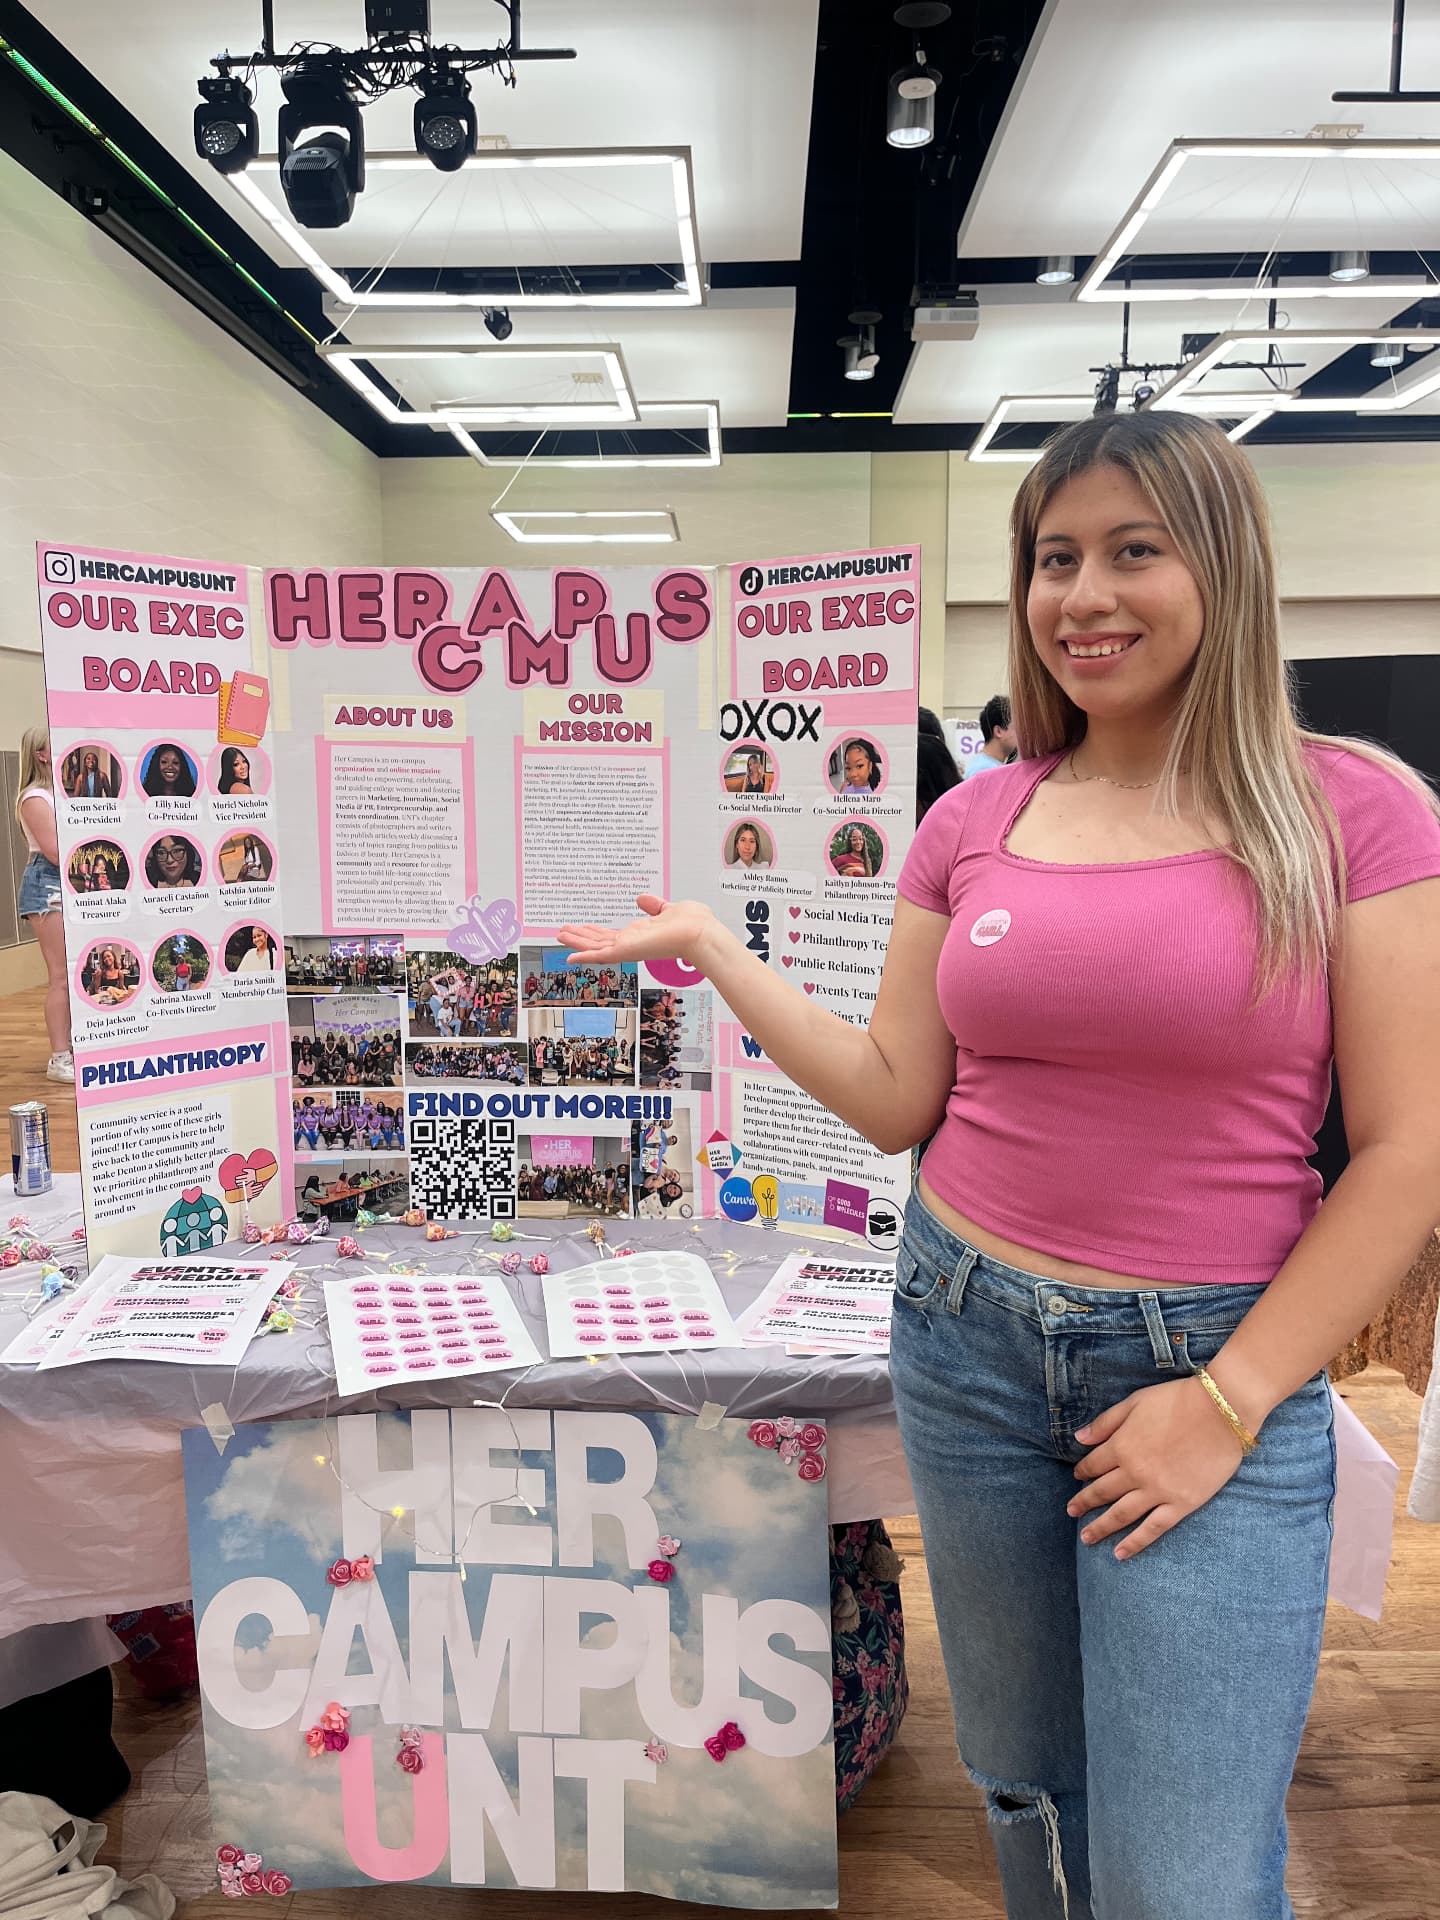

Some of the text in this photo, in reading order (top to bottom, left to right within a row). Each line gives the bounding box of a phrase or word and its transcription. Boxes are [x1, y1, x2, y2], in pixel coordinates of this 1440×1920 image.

[80, 560, 235, 592] HERCAMPUSUNT
[768, 554, 912, 585] HERCAMPUSUNT
[48, 592, 244, 640] OUR EXEC
[270, 572, 448, 642] HER
[738, 589, 914, 638] OUR EXEC
[83, 656, 221, 694] BOARD
[763, 653, 888, 693] BOARD
[568, 693, 623, 715] OUR
[335, 706, 454, 729] ABOUT US
[539, 721, 652, 743] MISSION
[148, 813, 198, 821] Co-President
[233, 812, 267, 820] President
[719, 804, 750, 812] Co-Social
[773, 805, 802, 813] Director
[813, 807, 902, 815] Co-Social Media Director
[68, 816, 121, 825] Co-President
[758, 885, 784, 895] Publicity
[786, 888, 812, 896] Director
[825, 879, 896, 889] Kaitlyn Johnson-Pra
[224, 897, 271, 907] Senior Editor
[825, 891, 896, 901] Philanthropy Direct
[81, 910, 120, 919] Treasurer
[160, 905, 194, 914] Secretary
[804, 908, 834, 921] Social
[837, 910, 869, 924] Media
[803, 933, 868, 951] Philanthropy
[794, 957, 825, 970] Public
[828, 960, 875, 975] Relations
[234, 978, 253, 986] Daria
[816, 984, 849, 998] Events
[151, 993, 211, 1005] Sabrina Maxwell
[222, 988, 266, 999] Membership
[147, 1004, 216, 1017] Co-Events Director
[87, 1015, 136, 1028] Deja Jackson
[74, 1025, 149, 1043] Co-Events Director
[82, 1042, 266, 1088] PHILANTHROPY
[753, 1083, 766, 1092] Her
[768, 1086, 797, 1097] Campus,
[408, 1092, 672, 1120] FIND OUT MORE!!!
[744, 1094, 788, 1107] Development
[90, 1103, 202, 1131] Community service is good
[744, 1105, 841, 1127] further develop their college
[91, 1112, 221, 1145] portion of why some of these girls
[744, 1118, 848, 1140] prepare them for their desired
[91, 1123, 225, 1157] joined! Her Campus is here to help
[744, 1129, 781, 1140] workshops
[797, 1137, 847, 1152] career-related
[849, 1147, 871, 1157] events
[92, 1159, 109, 1170] give
[111, 1154, 130, 1165] back
[156, 1141, 198, 1156] community
[201, 1137, 215, 1147] and
[743, 1140, 863, 1167] collaborations with companies and
[93, 1147, 230, 1182] make Denton slightly better place.
[742, 1161, 807, 1180] hands-on learning.
[743, 1151, 895, 1185] organizations, panels, and opportunities for
[94, 1161, 214, 1194] We prioritize philanthropy and
[94, 1174, 212, 1207] involvement in the community
[724, 1192, 755, 1205] Canva
[837, 1198, 851, 1207] GOOD
[95, 1205, 124, 1220] around
[130, 1273, 263, 1282] SCHEDULE
[138, 1266, 235, 1274] EVENTS
[804, 1263, 895, 1275] EVENTS
[798, 1273, 896, 1284] SCHEDU
[337, 1407, 664, 1570] HER
[196, 1570, 833, 1758] CAMPUS
[338, 1731, 658, 1892] UNT
